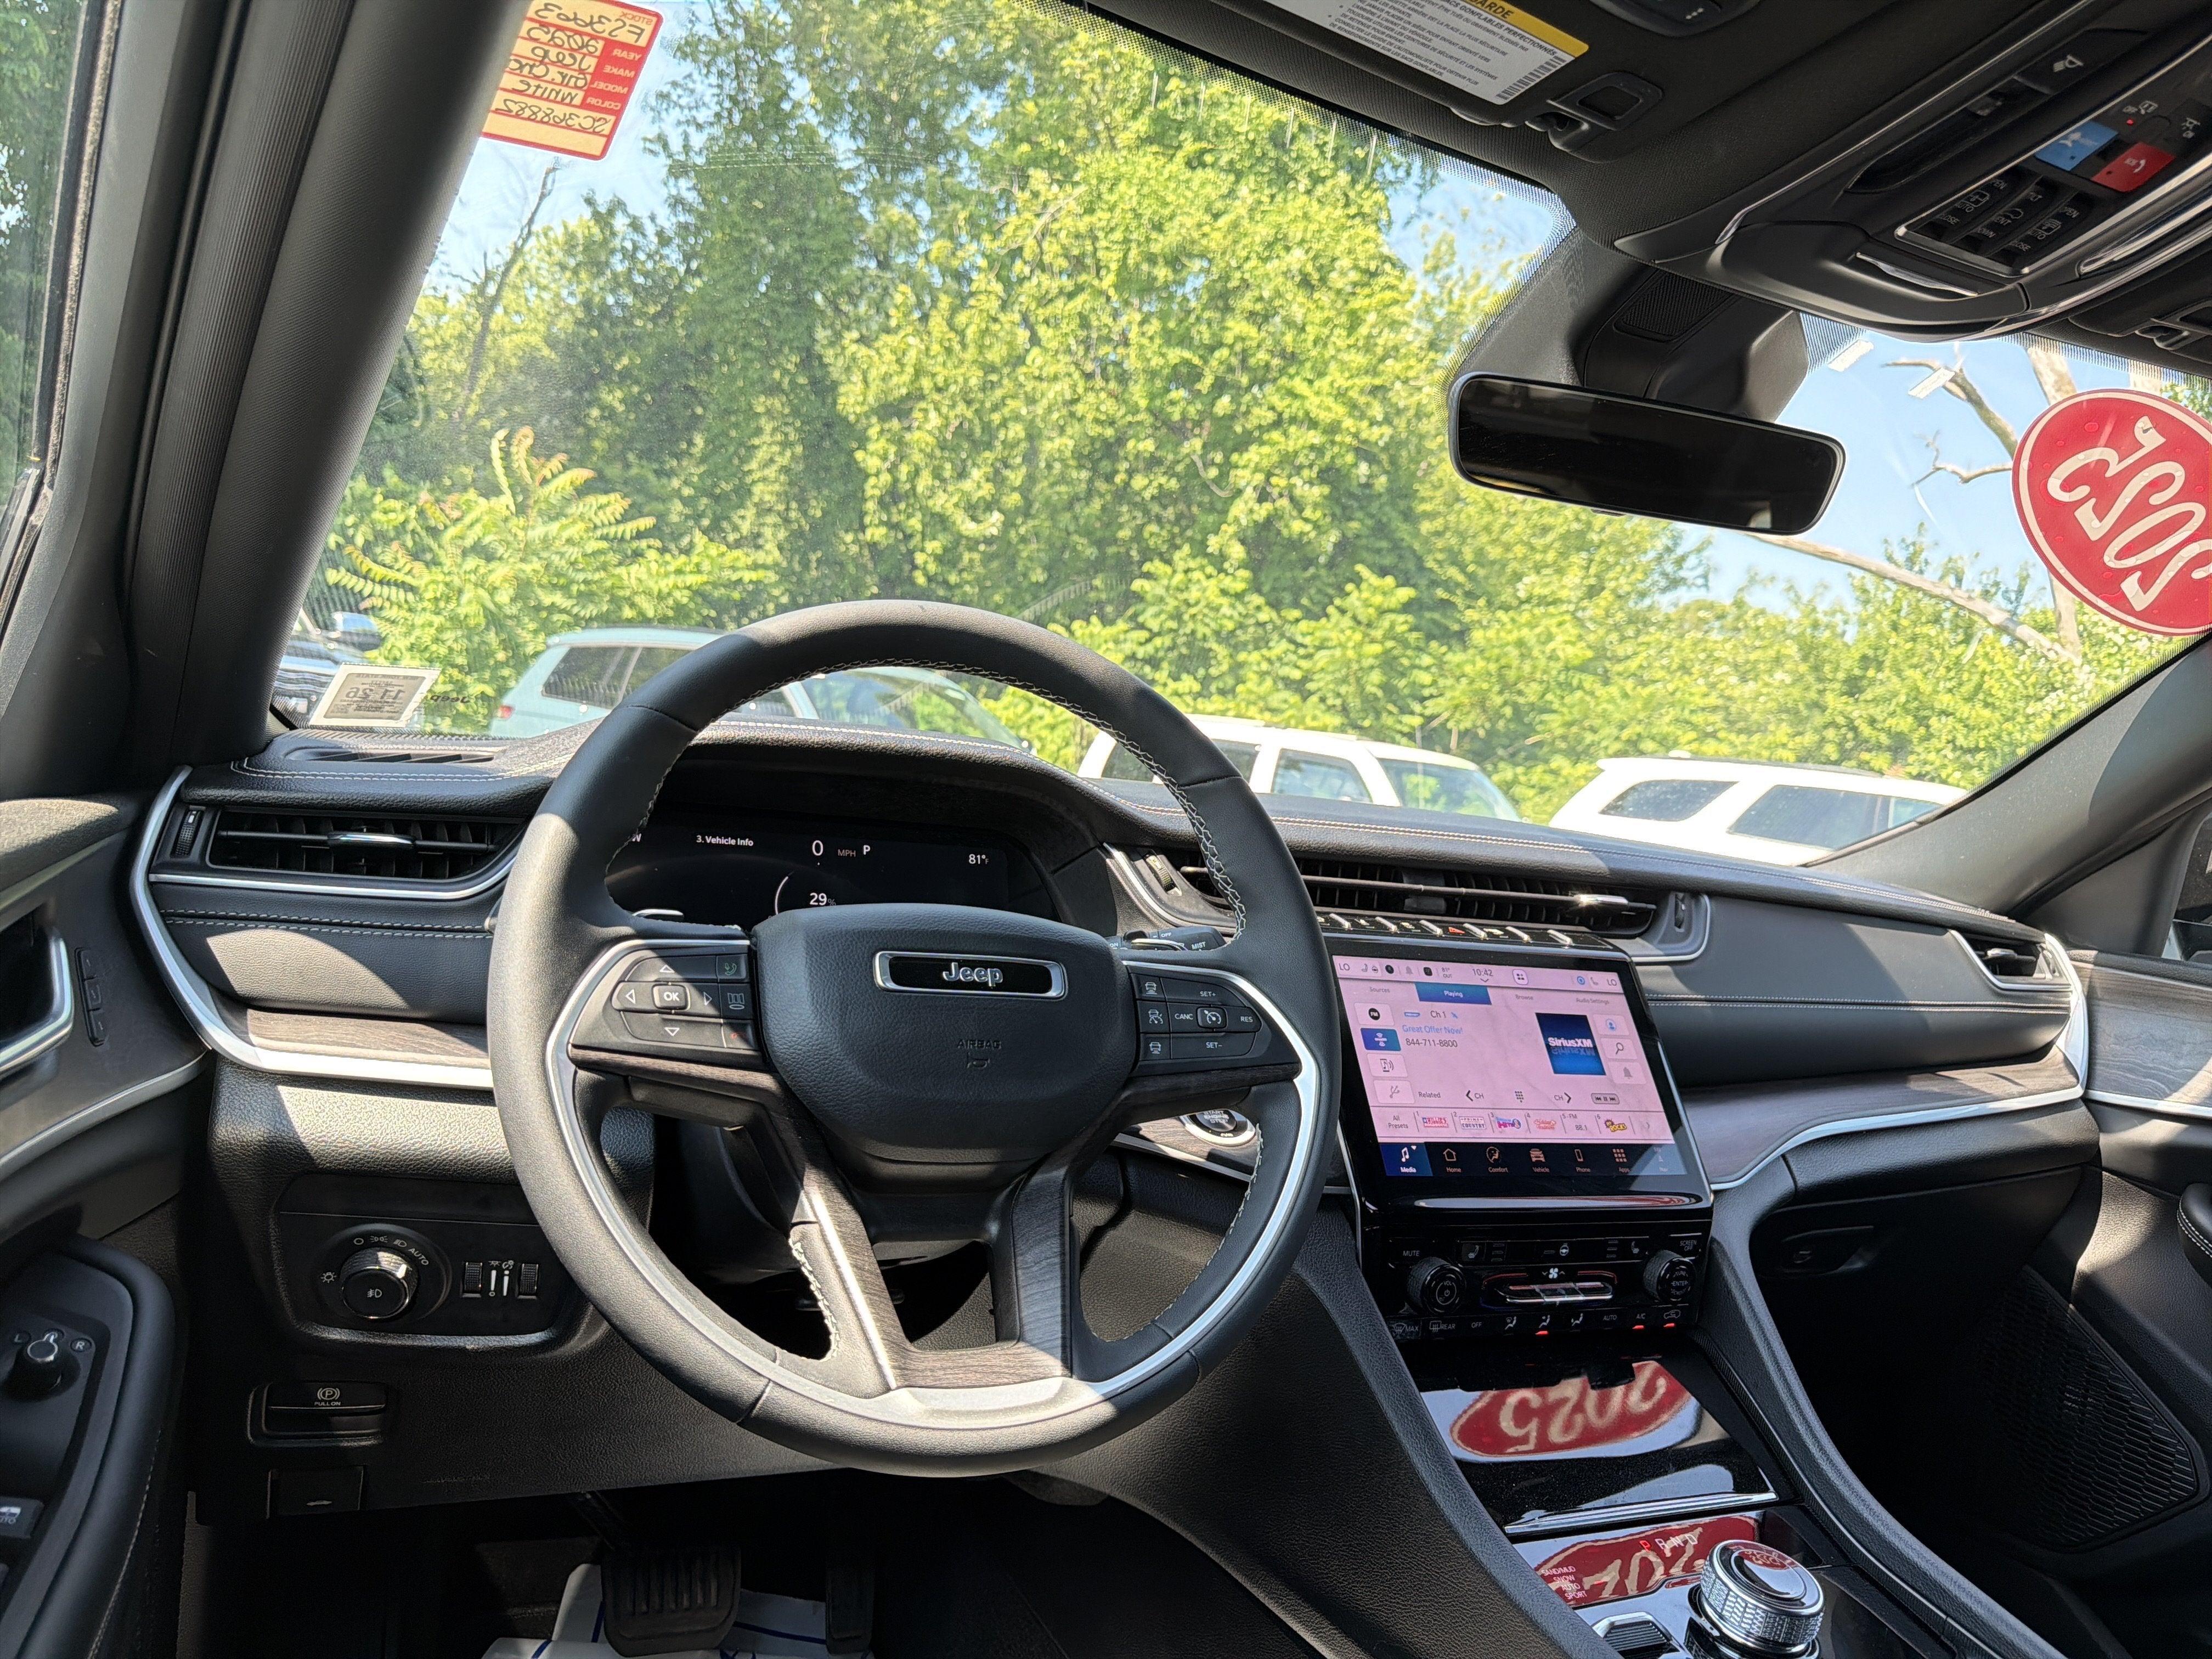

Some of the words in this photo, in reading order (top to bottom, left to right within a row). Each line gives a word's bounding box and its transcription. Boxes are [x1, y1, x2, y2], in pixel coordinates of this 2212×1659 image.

[1469, 0, 1514, 19] ARDE
[1459, 5, 1504, 29] GONFLABLES
[1504, 27, 1558, 55] PERFECTIONNÉS
[696, 835, 704, 843] 3.
[706, 836, 736, 845] Vehicle
[812, 840, 823, 856] 0
[838, 849, 856, 857] MPH
[864, 845, 871, 855] P
[1192, 941, 1206, 950] MIST
[1339, 963, 1350, 971] LO
[943, 963, 1003, 986] Jeep
[1472, 968, 1493, 977] 10:42
[664, 991, 680, 1002] OK
[1402, 1025, 1423, 1033] Great
[957, 1040, 1001, 1049] AIRBAG
[1406, 1038, 1458, 1047] 844-711-8800
[1548, 1037, 1593, 1048] SiriusXM
[408, 1247, 430, 1266] AUTO
[14, 1334, 22, 1342] L
[75, 1341, 84, 1350] R
[1639, 1540, 1651, 1552] P
[1655, 1538, 1668, 1549] R
[1669, 1536, 1684, 1547] N
[1685, 1534, 1699, 1545] D
[1541, 1566, 1576, 1577] SAND/MUD
[1553, 1575, 1576, 1583] SNOW
[1561, 1583, 1581, 1592] AUTO
[1565, 1590, 1588, 1600] SPORT
